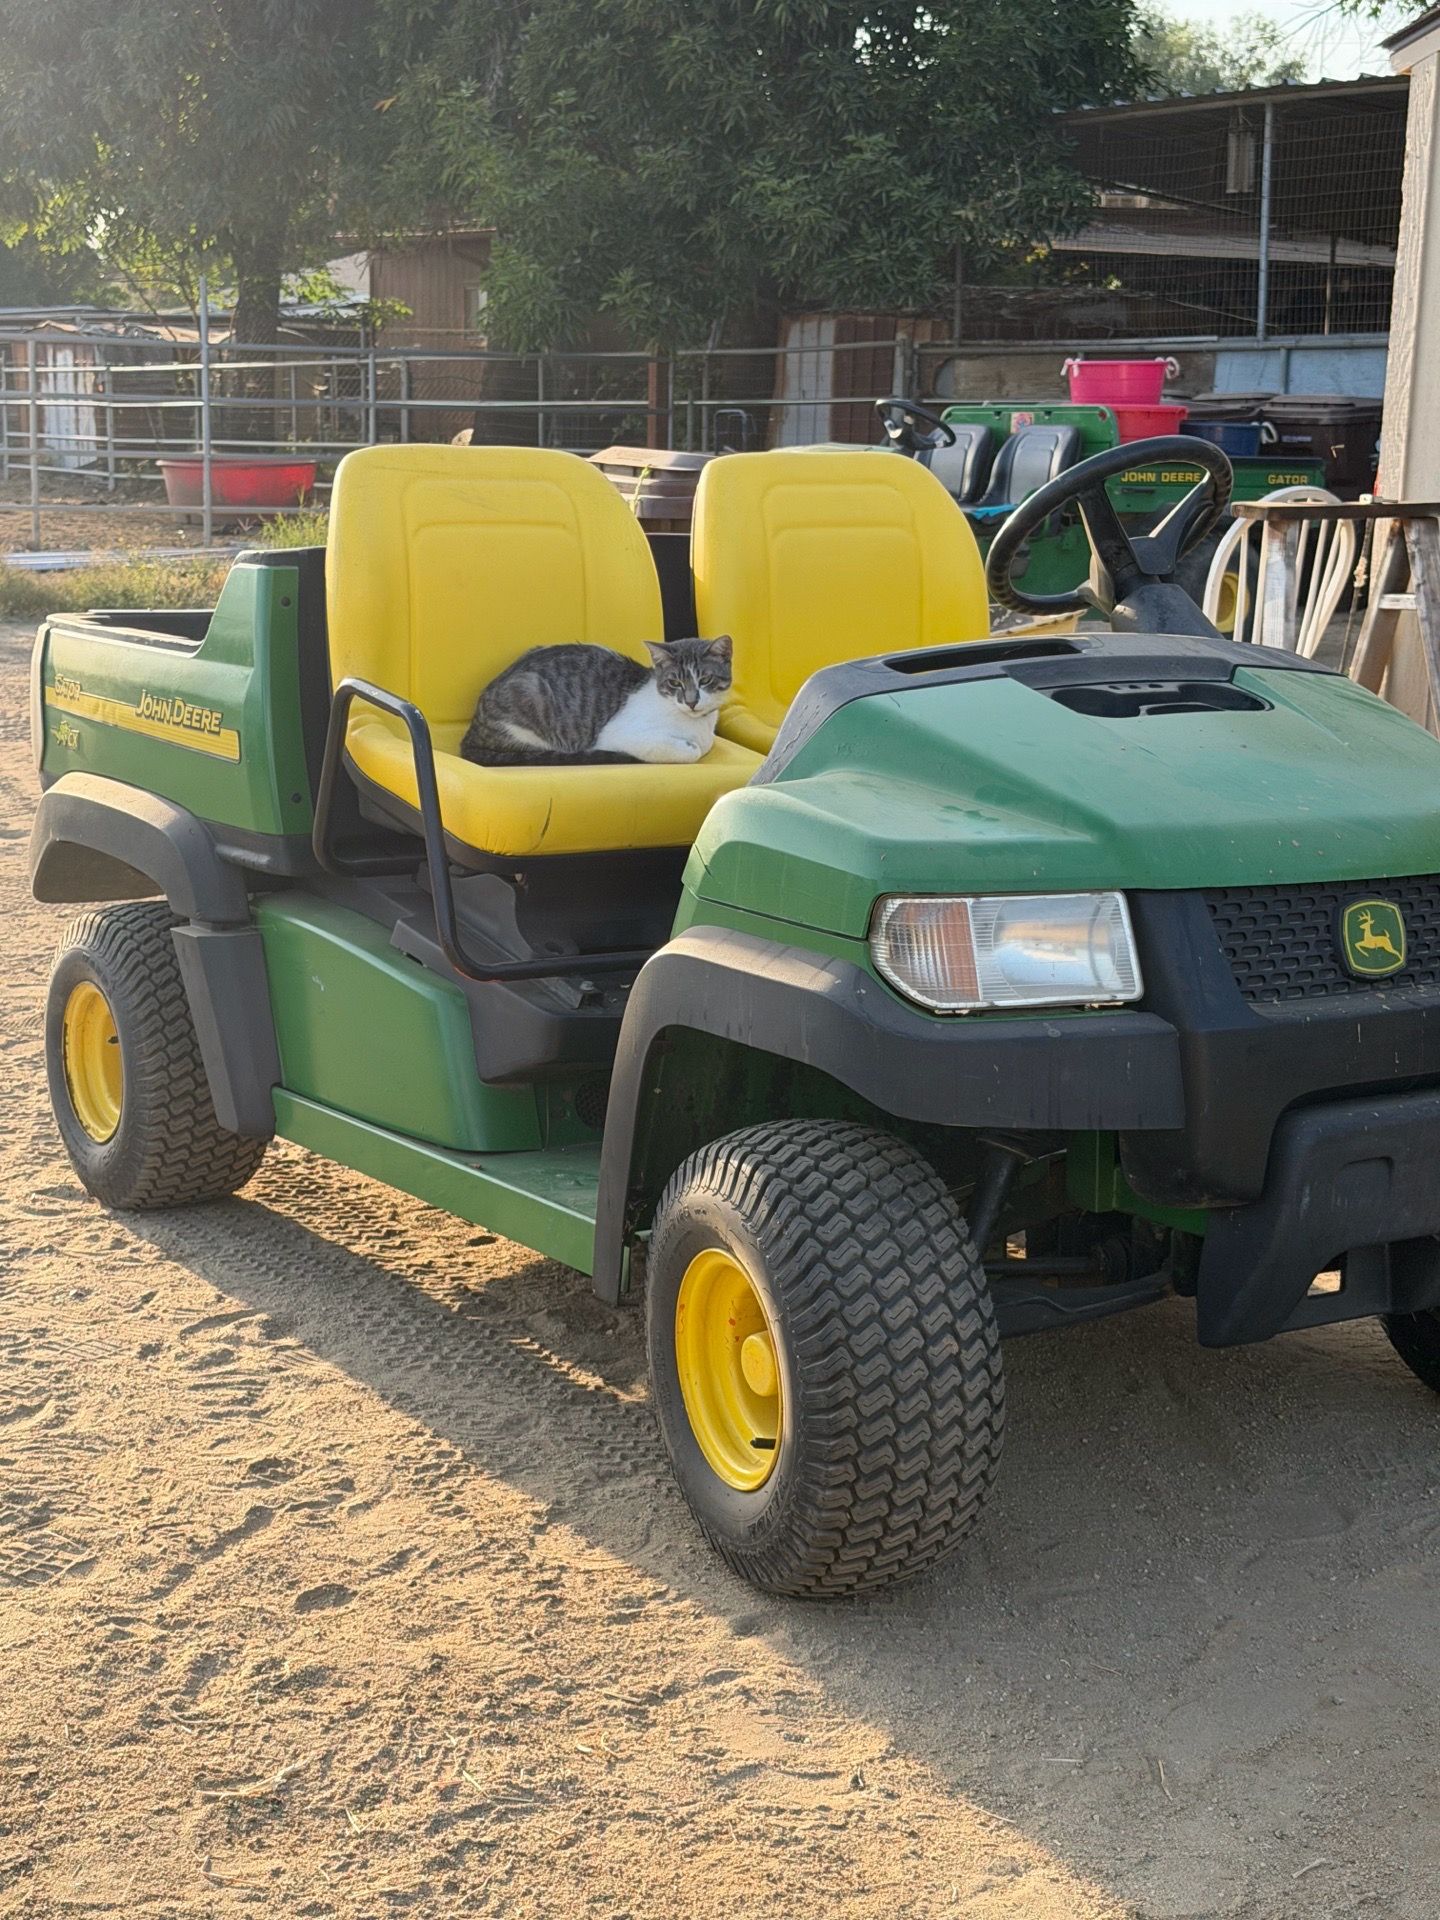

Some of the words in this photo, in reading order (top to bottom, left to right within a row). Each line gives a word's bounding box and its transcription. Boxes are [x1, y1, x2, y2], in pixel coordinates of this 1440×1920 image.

[1120, 471, 1156, 483] JOHN
[1161, 472, 1201, 483] DEERE
[1267, 474, 1308, 485] GATOR
[134, 689, 173, 725] JOHN
[174, 697, 223, 735] DEERE
